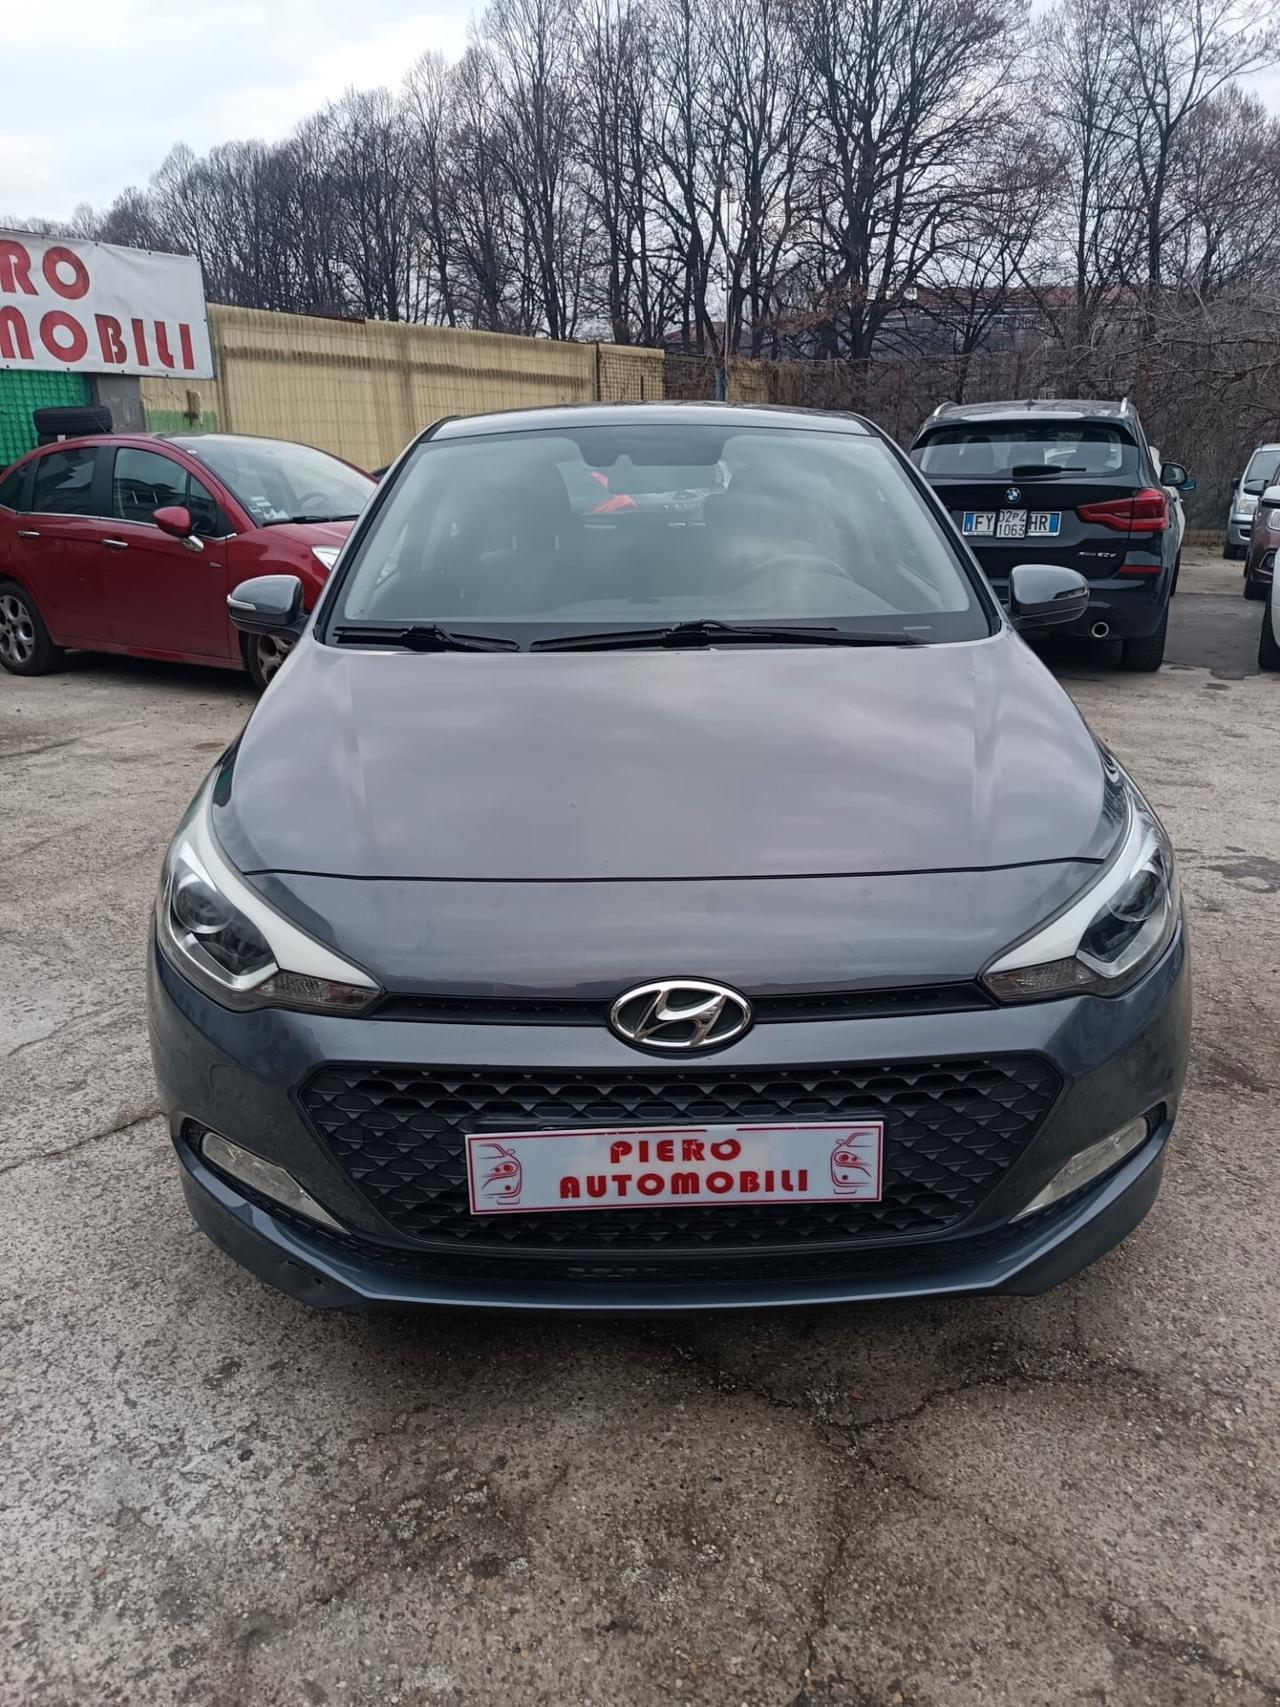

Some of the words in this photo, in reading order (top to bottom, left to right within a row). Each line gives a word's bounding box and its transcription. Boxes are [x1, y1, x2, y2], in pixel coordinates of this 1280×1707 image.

[974, 515, 994, 530] FY
[1029, 515, 1048, 531] HR
[998, 523, 1025, 536] 1063
[610, 1138, 741, 1164] PIERO
[560, 1169, 809, 1199] AUTOMOBILI
